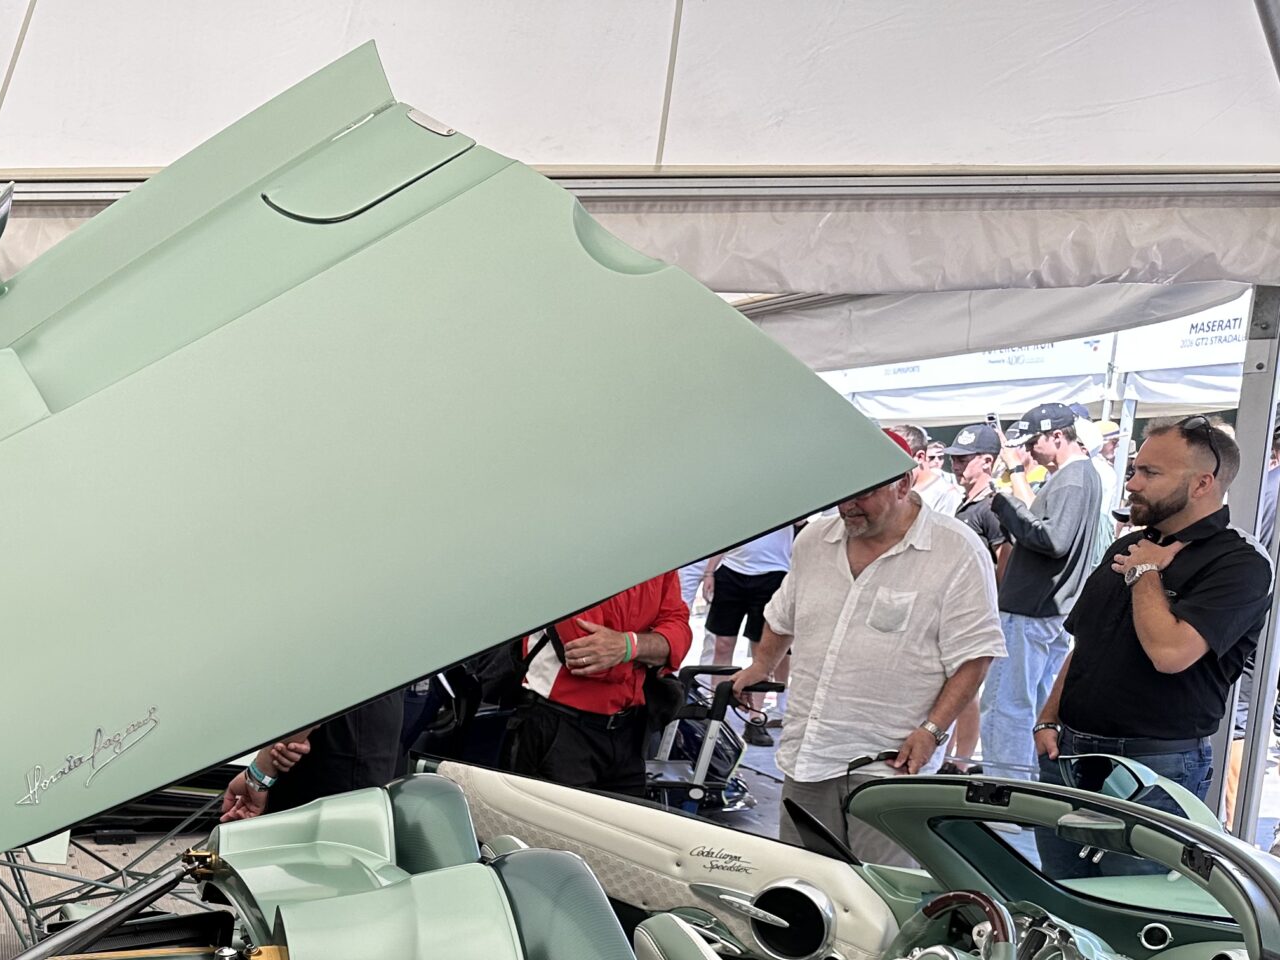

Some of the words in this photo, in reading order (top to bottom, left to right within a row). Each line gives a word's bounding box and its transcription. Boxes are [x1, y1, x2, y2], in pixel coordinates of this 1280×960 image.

[1189, 317, 1243, 335] MASERATI
[1195, 337, 1209, 347] GT2
[703, 859, 760, 875] Speedster
